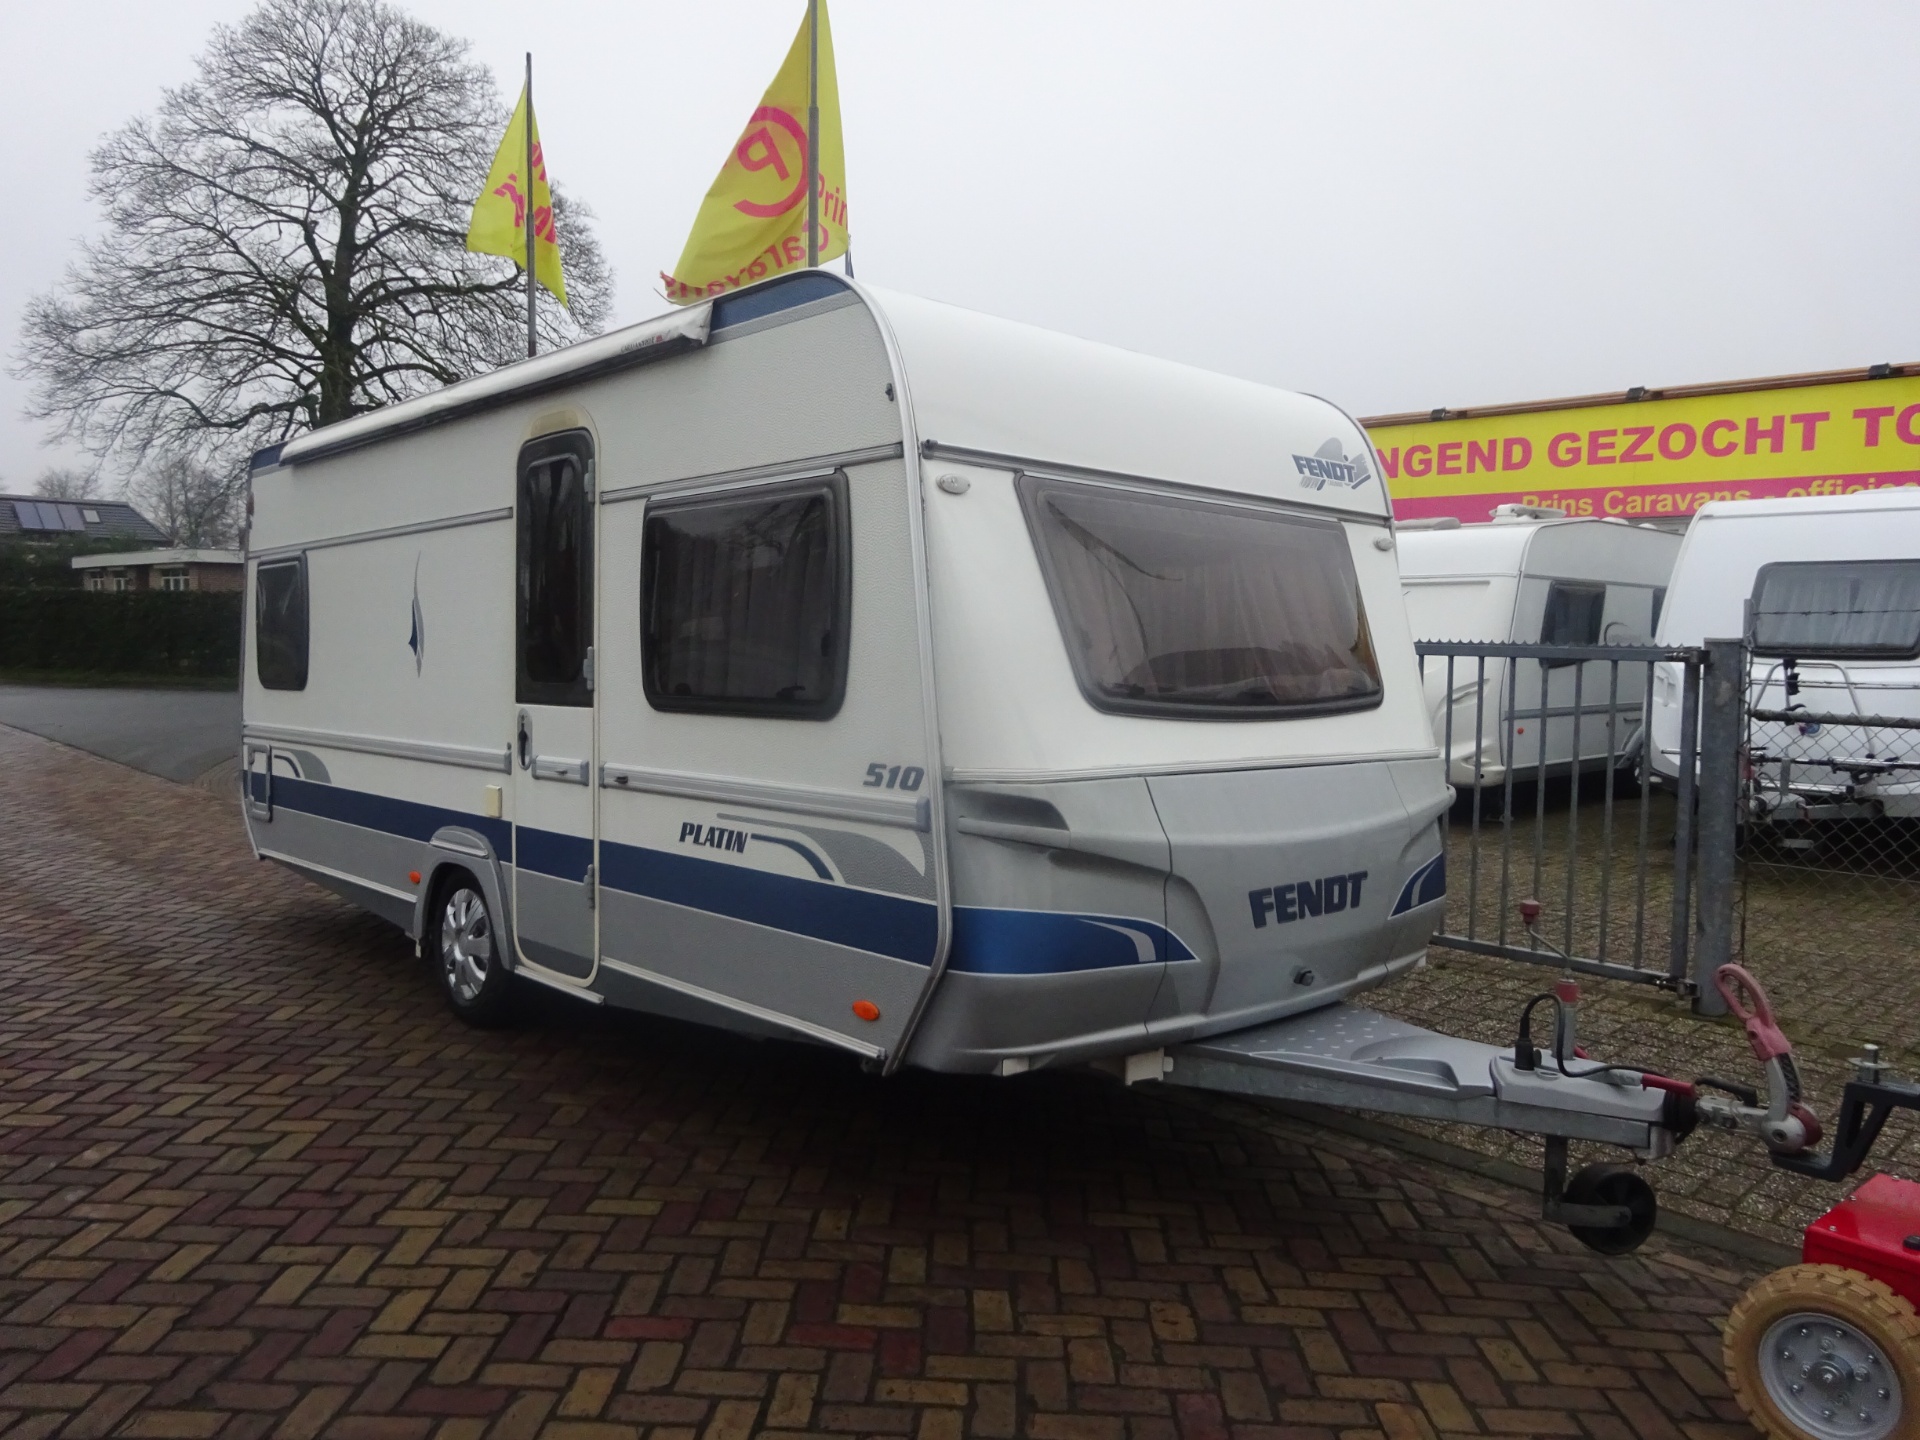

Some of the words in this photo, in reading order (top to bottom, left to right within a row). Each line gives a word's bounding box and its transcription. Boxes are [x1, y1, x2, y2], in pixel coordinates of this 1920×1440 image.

[1547, 411, 1831, 468] GEZOCHT
[1292, 454, 1357, 483] FENDT
[1604, 489, 1751, 514] Caravans
[862, 762, 925, 791] 510
[679, 822, 748, 853] PLATIN
[1248, 870, 1368, 929] FENDT
